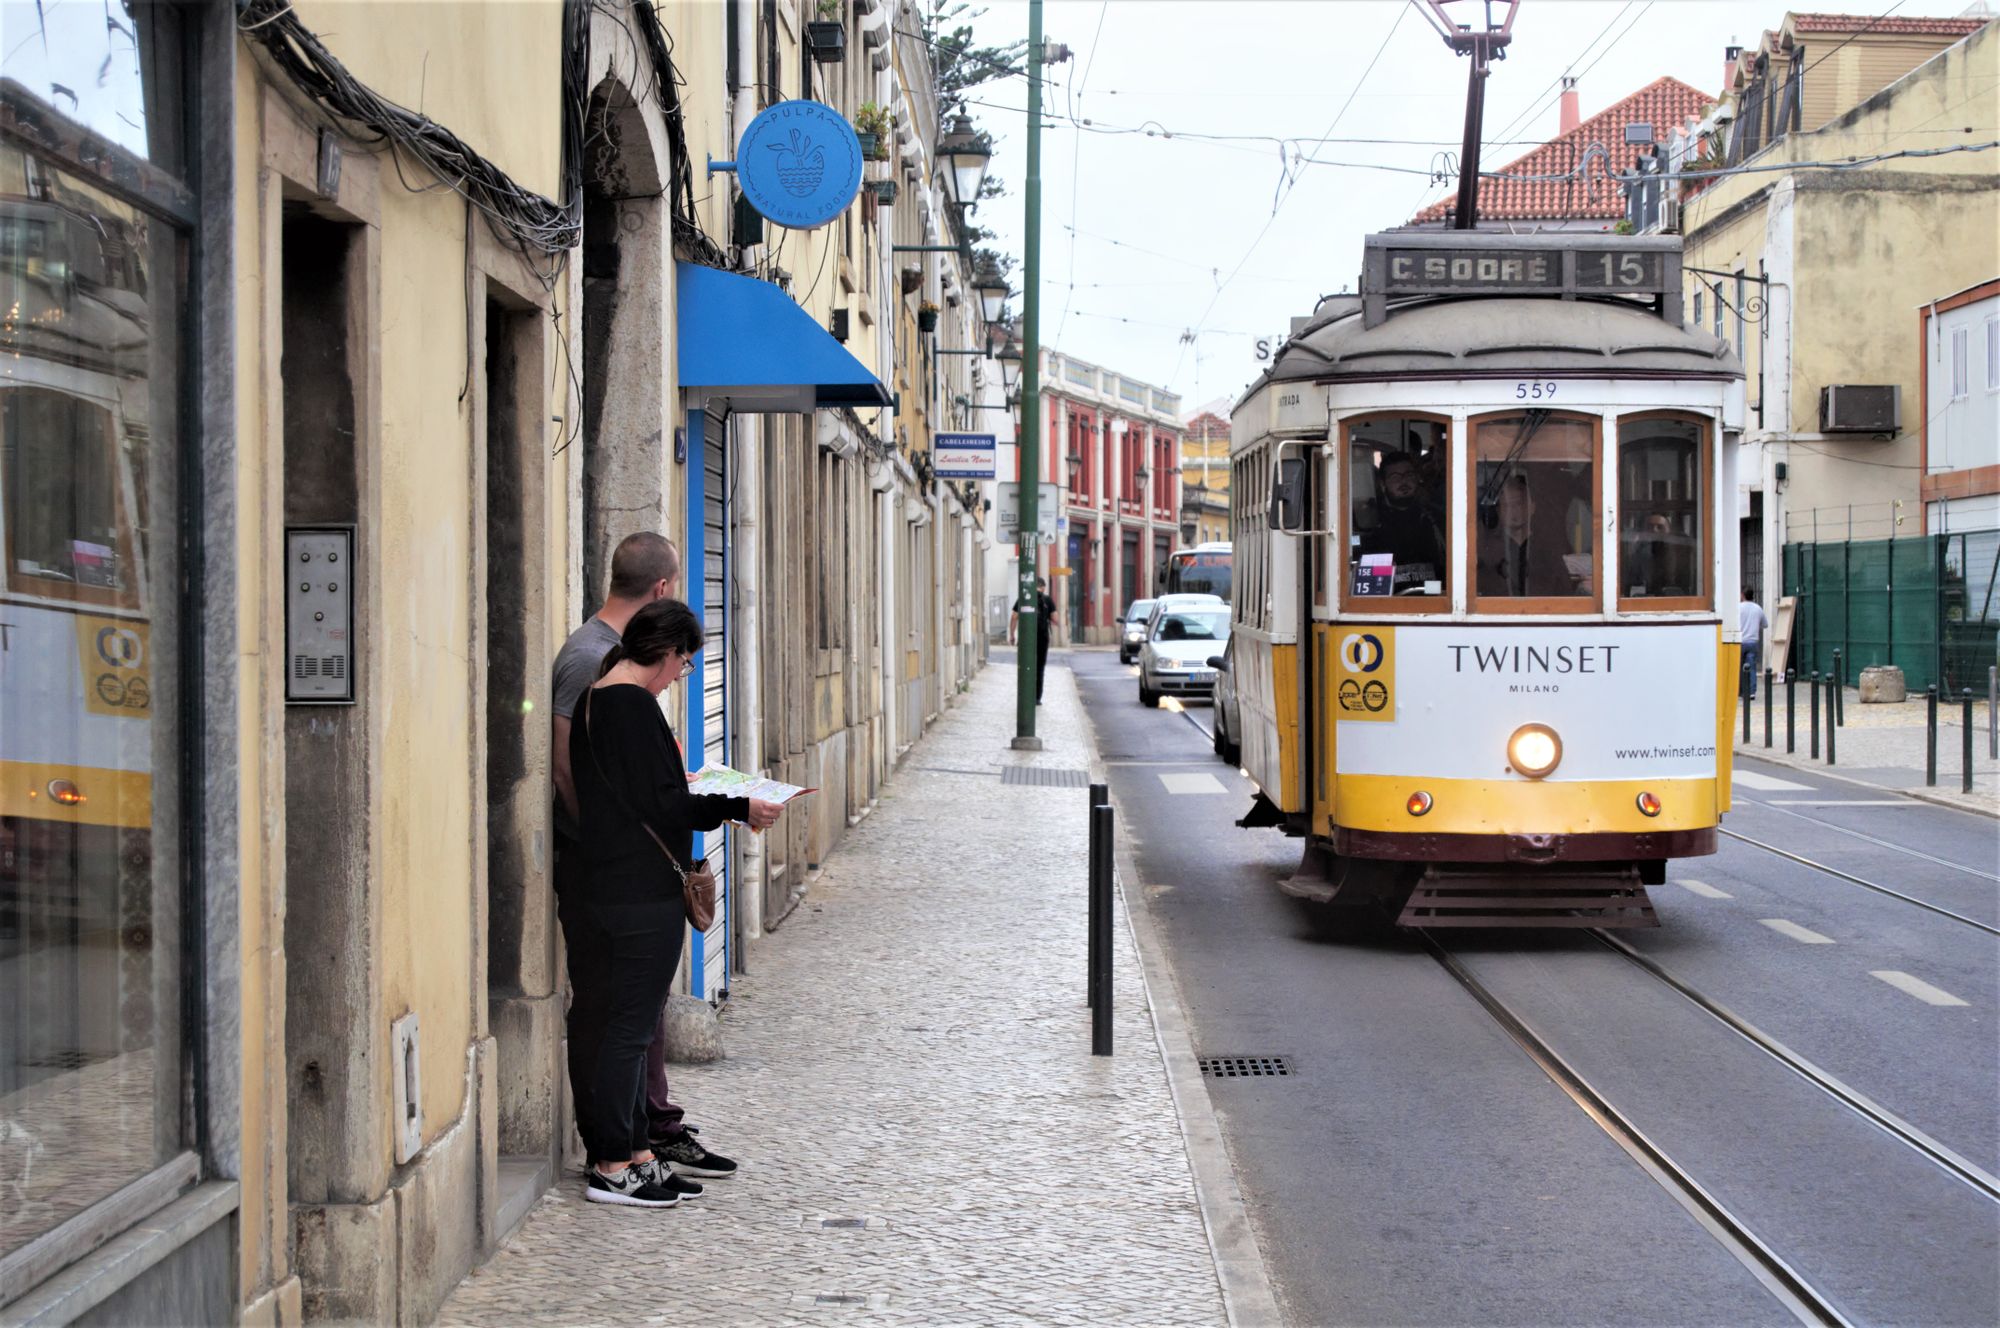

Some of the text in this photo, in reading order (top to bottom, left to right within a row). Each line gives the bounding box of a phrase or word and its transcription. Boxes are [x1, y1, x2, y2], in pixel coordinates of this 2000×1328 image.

[770, 107, 824, 122] PULPA
[754, 190, 847, 219] NATURAL FOOD
[1425, 257, 1547, 282] SODRÉ
[1600, 252, 1644, 286] 15
[1256, 340, 1269, 360] S
[1516, 382, 1557, 399] 559
[1357, 568, 1371, 577] 15E
[1356, 582, 1370, 594] 15
[1447, 645, 1621, 674] TWINSET
[1508, 684, 1560, 693] MILANO
[1615, 744, 1717, 759] www.twinset.com
